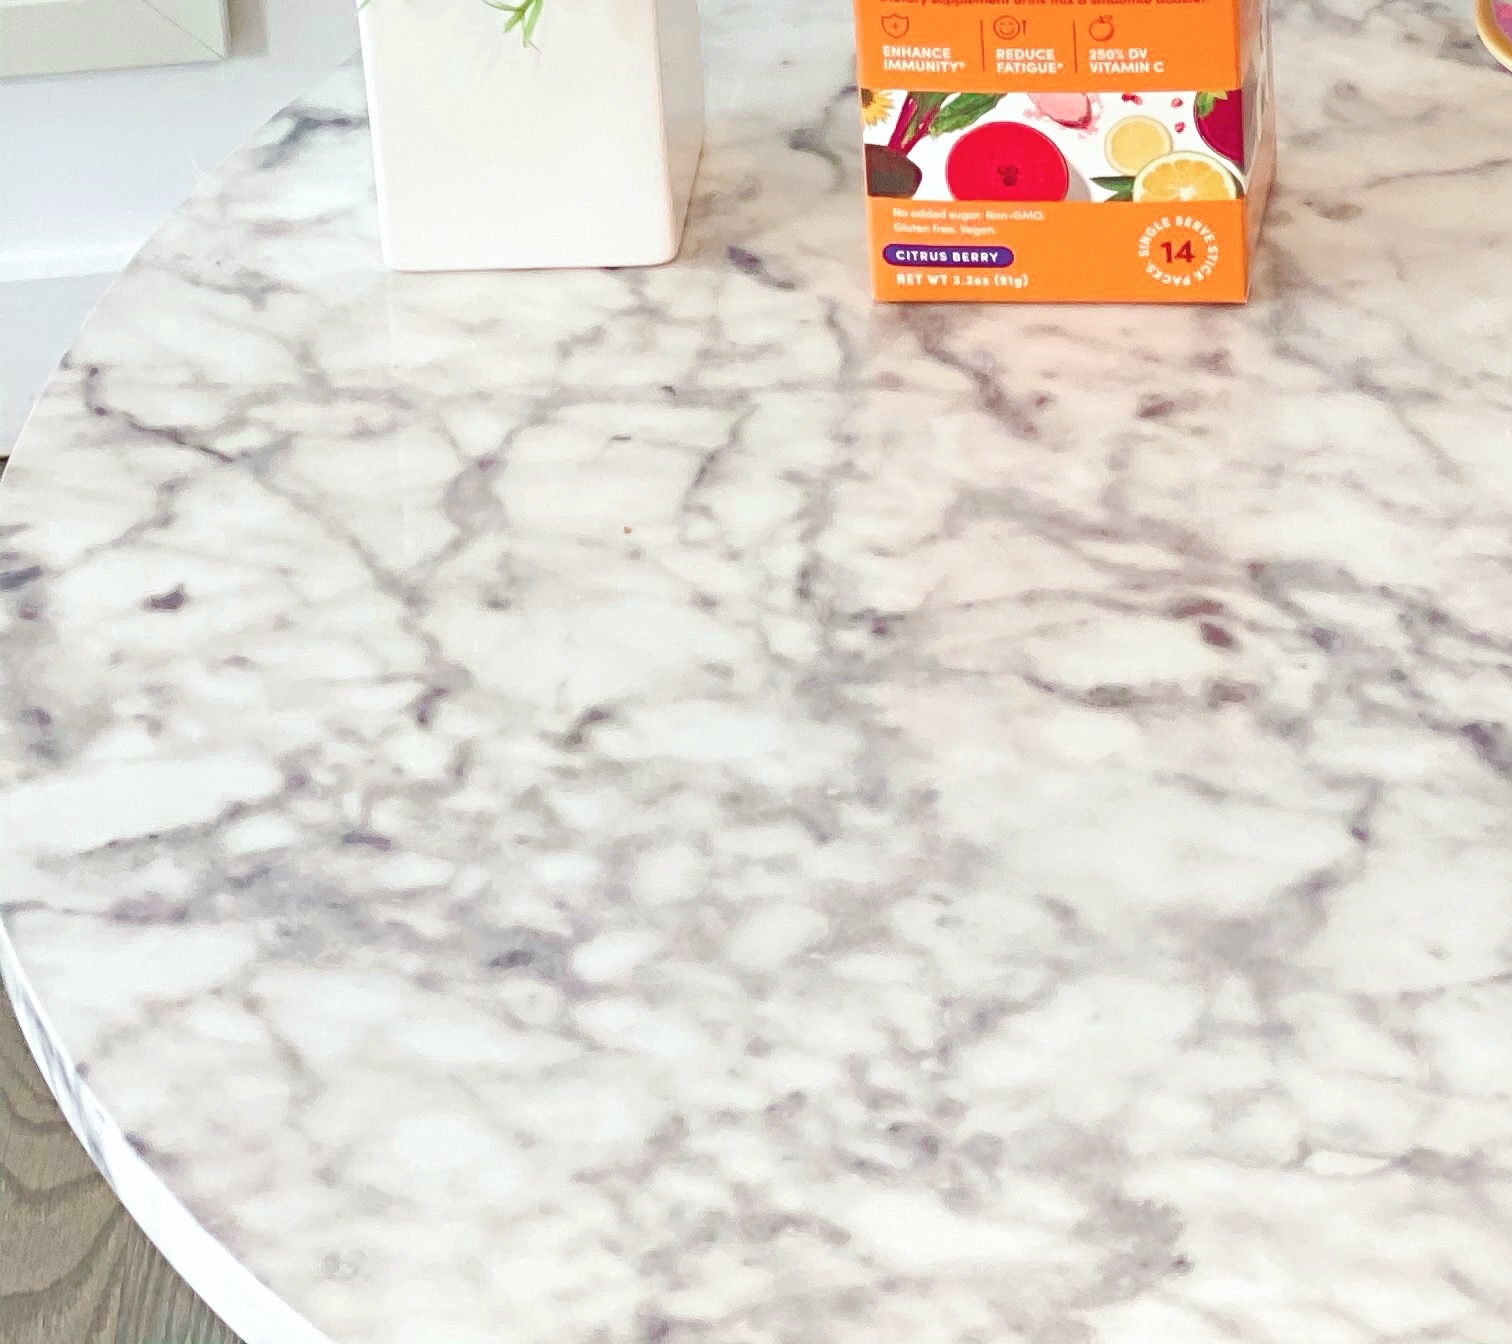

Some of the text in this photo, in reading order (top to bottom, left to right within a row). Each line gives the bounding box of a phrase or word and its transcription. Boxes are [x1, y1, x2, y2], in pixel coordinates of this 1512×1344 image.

[882, 44, 952, 59] ENHANCE
[996, 48, 1055, 61] REDUCE
[1088, 48, 1148, 61] 250% DV
[1089, 61, 1165, 74] VITAMIN C
[892, 207, 908, 218] No
[910, 208, 947, 219] added
[893, 222, 930, 233] Gluten
[895, 250, 999, 263] CITRUS BERRY
[1138, 215, 1219, 286] SINGLE SERVE STICK PACKS
[1161, 240, 1196, 264] 14
[896, 273, 922, 286] NET
[927, 273, 948, 286] WT
